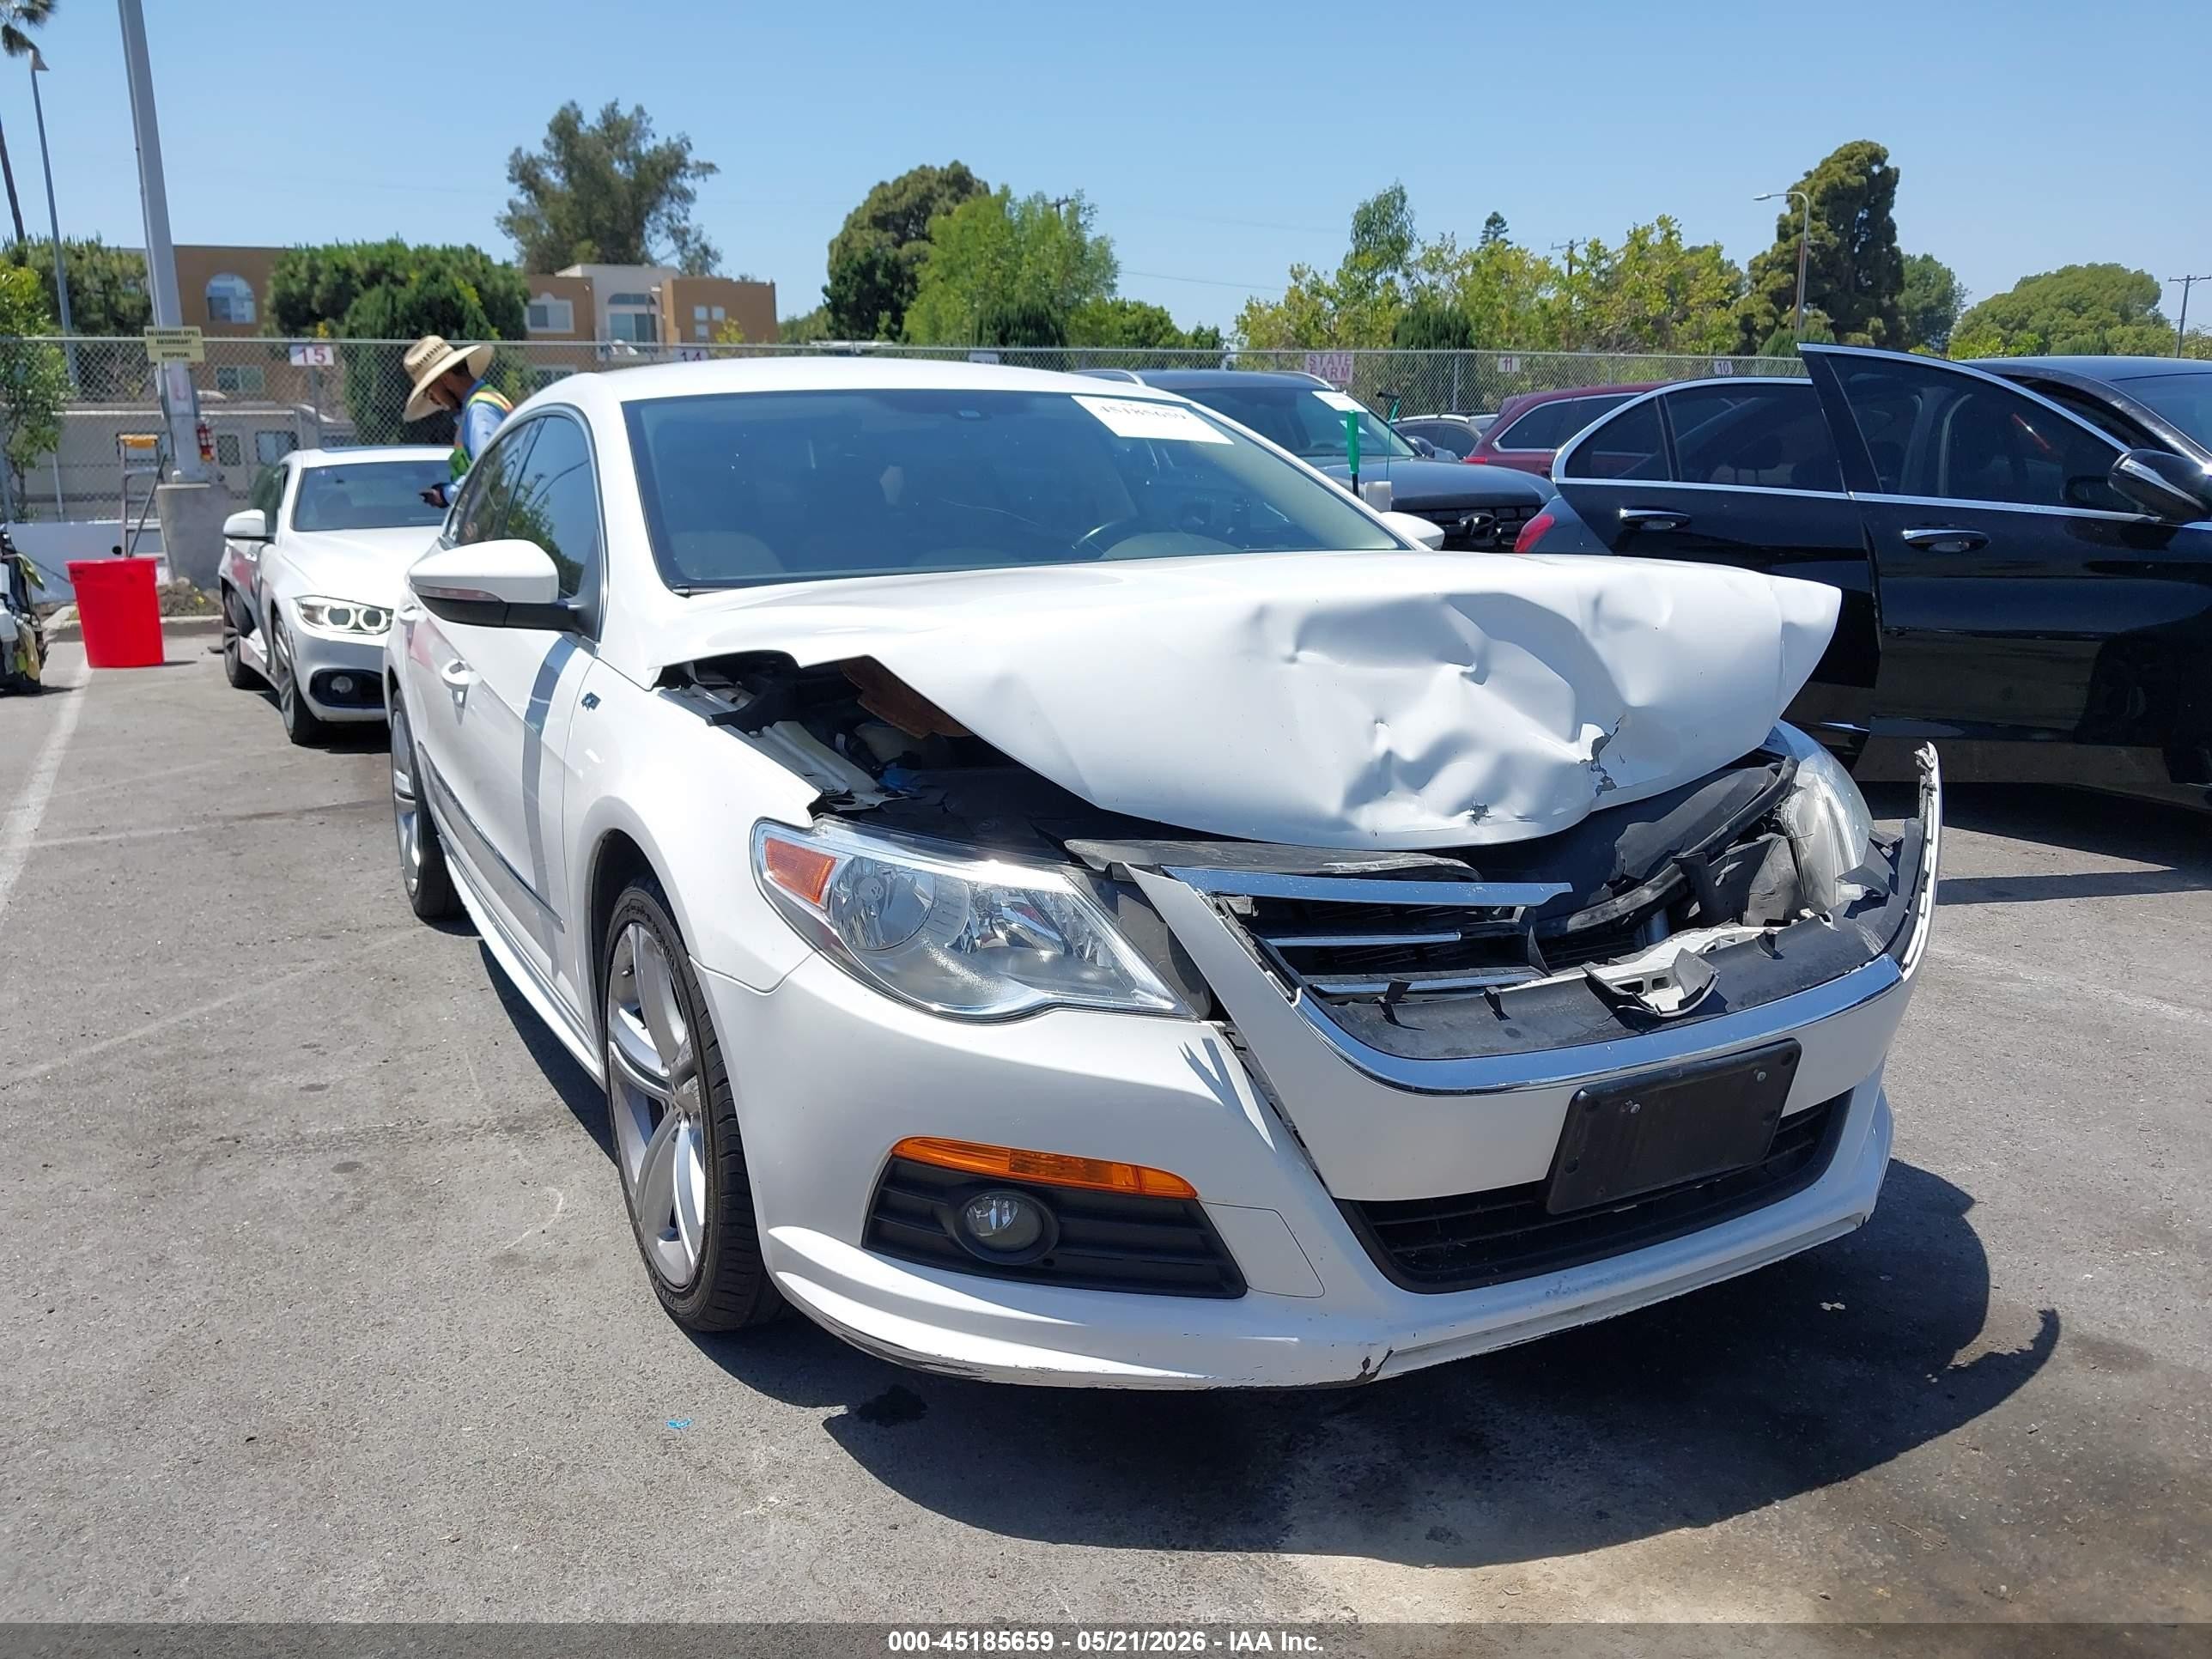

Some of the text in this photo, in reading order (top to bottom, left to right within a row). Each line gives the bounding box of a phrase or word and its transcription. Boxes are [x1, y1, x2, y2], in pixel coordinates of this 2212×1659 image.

[301, 345, 326, 365] 15
[1309, 354, 1352, 366] STATE
[1503, 356, 1512, 371] 11
[1718, 362, 1729, 374] 10
